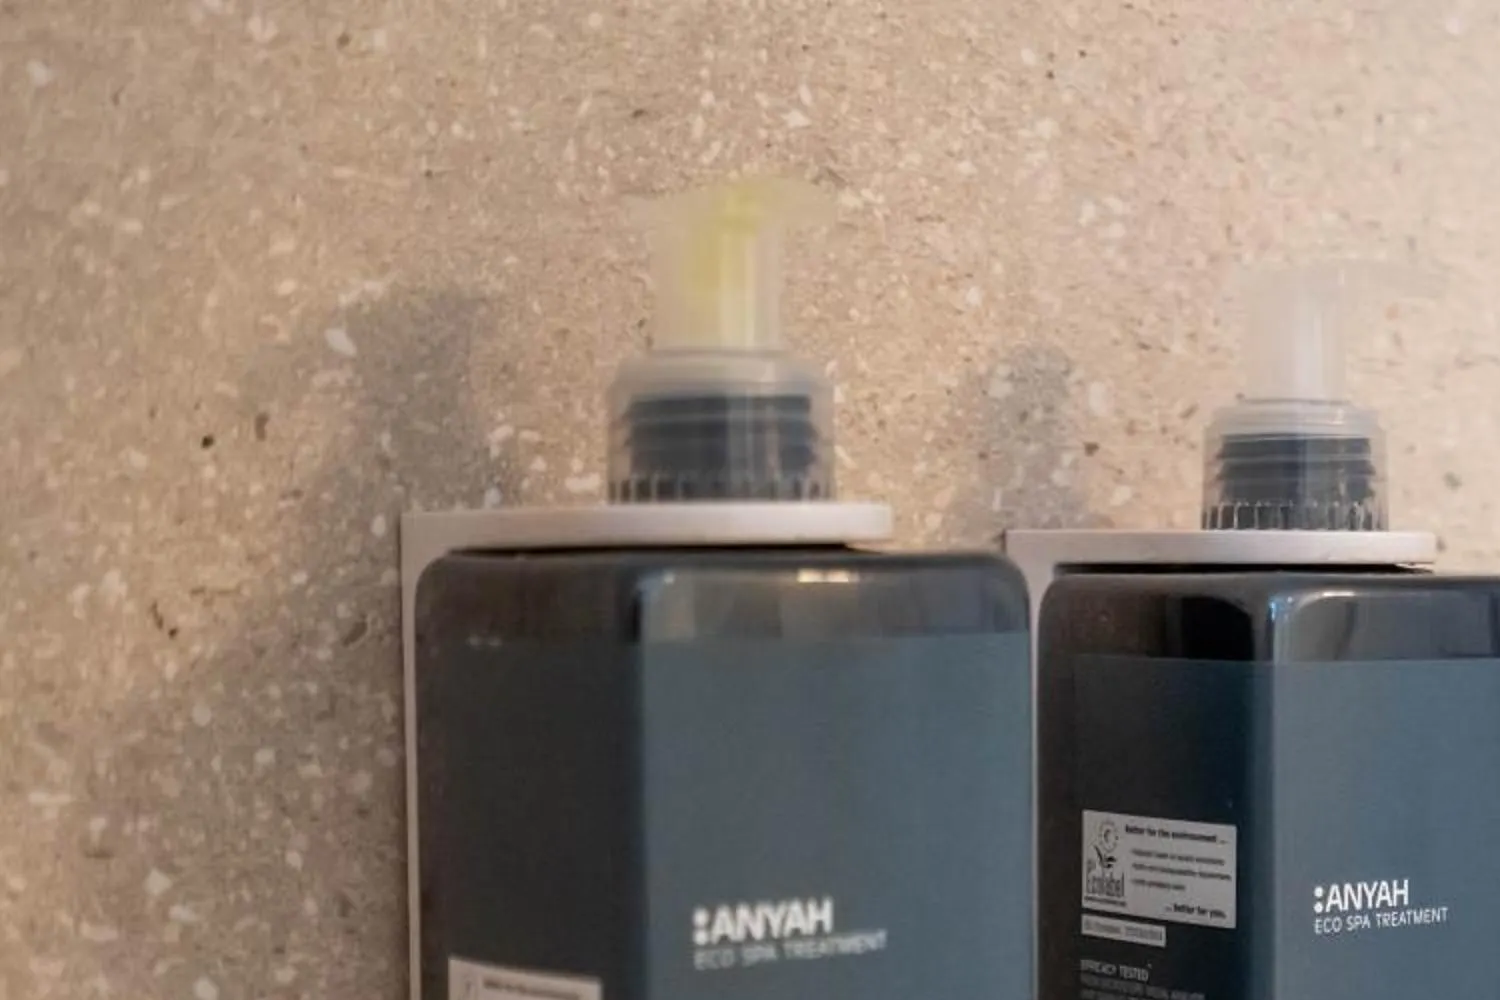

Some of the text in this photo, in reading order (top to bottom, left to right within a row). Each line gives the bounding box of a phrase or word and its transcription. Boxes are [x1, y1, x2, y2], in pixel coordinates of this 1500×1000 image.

[1313, 907, 1448, 935] ECO SPA TREATMENT
[694, 946, 736, 971] ECO
[741, 944, 778, 967] SPA
